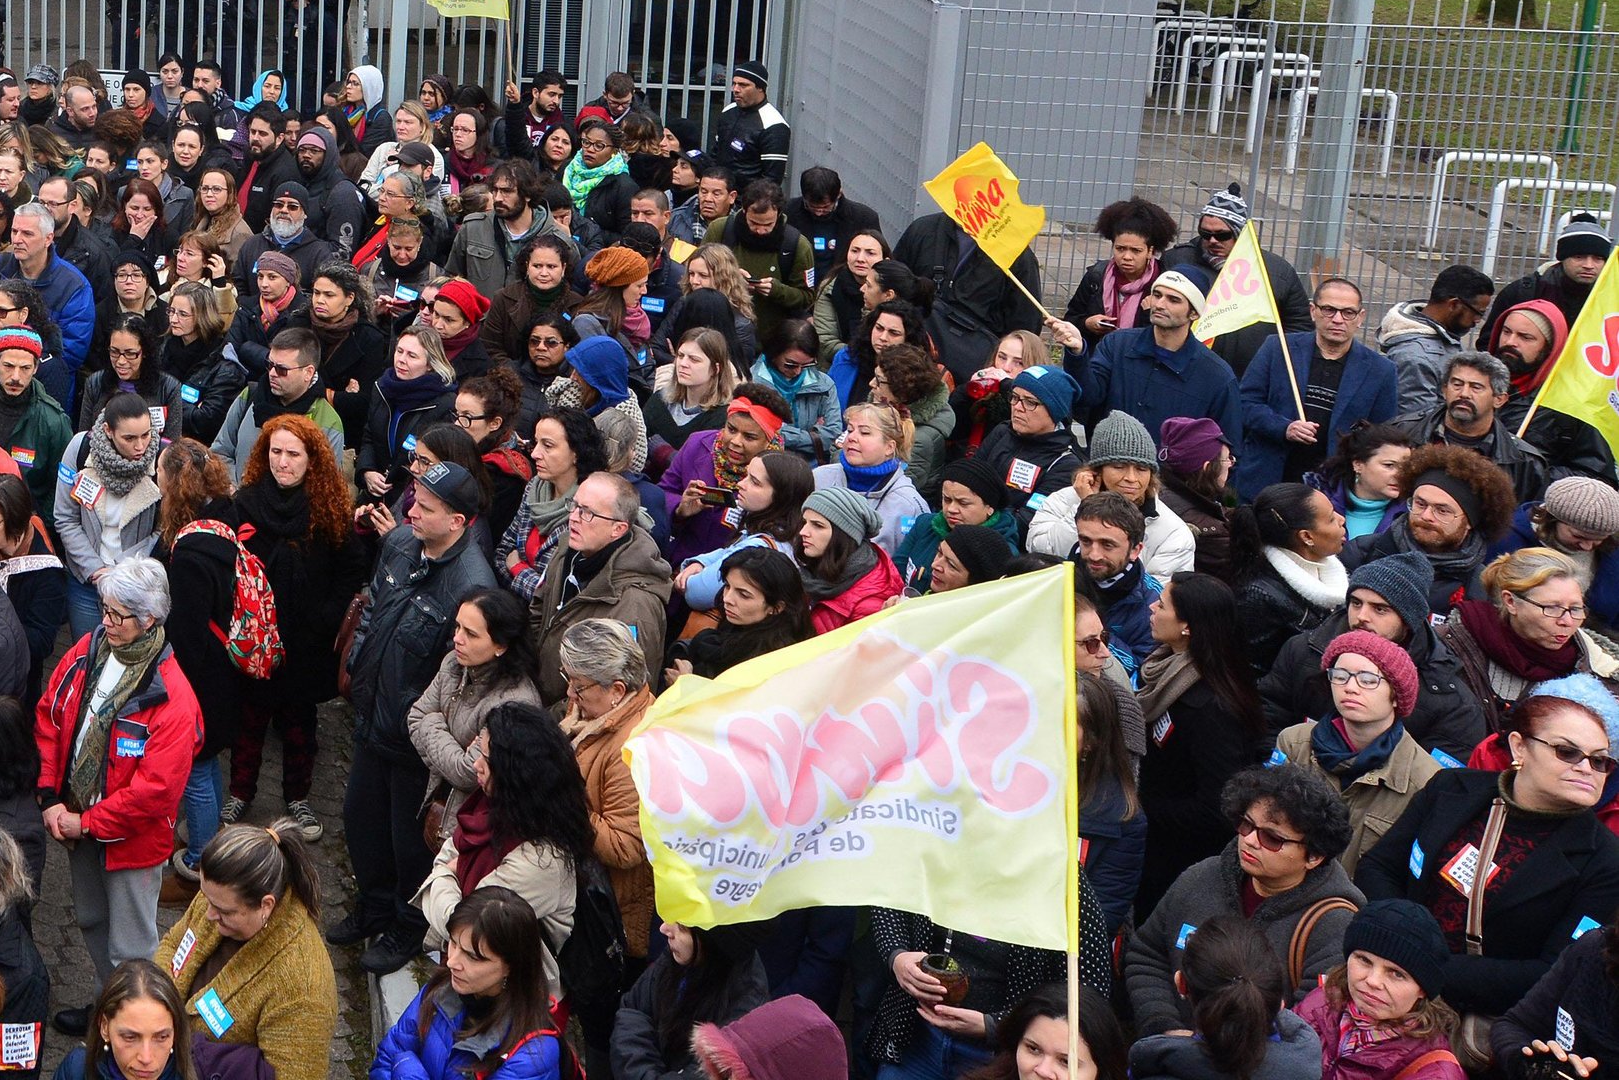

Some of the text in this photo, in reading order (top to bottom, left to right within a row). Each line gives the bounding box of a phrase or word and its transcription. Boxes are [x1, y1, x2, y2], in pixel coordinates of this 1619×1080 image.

[954, 177, 1005, 238] Simpa
[5, 1025, 32, 1034] DERROTAR
[11, 1046, 30, 1054] carreira
